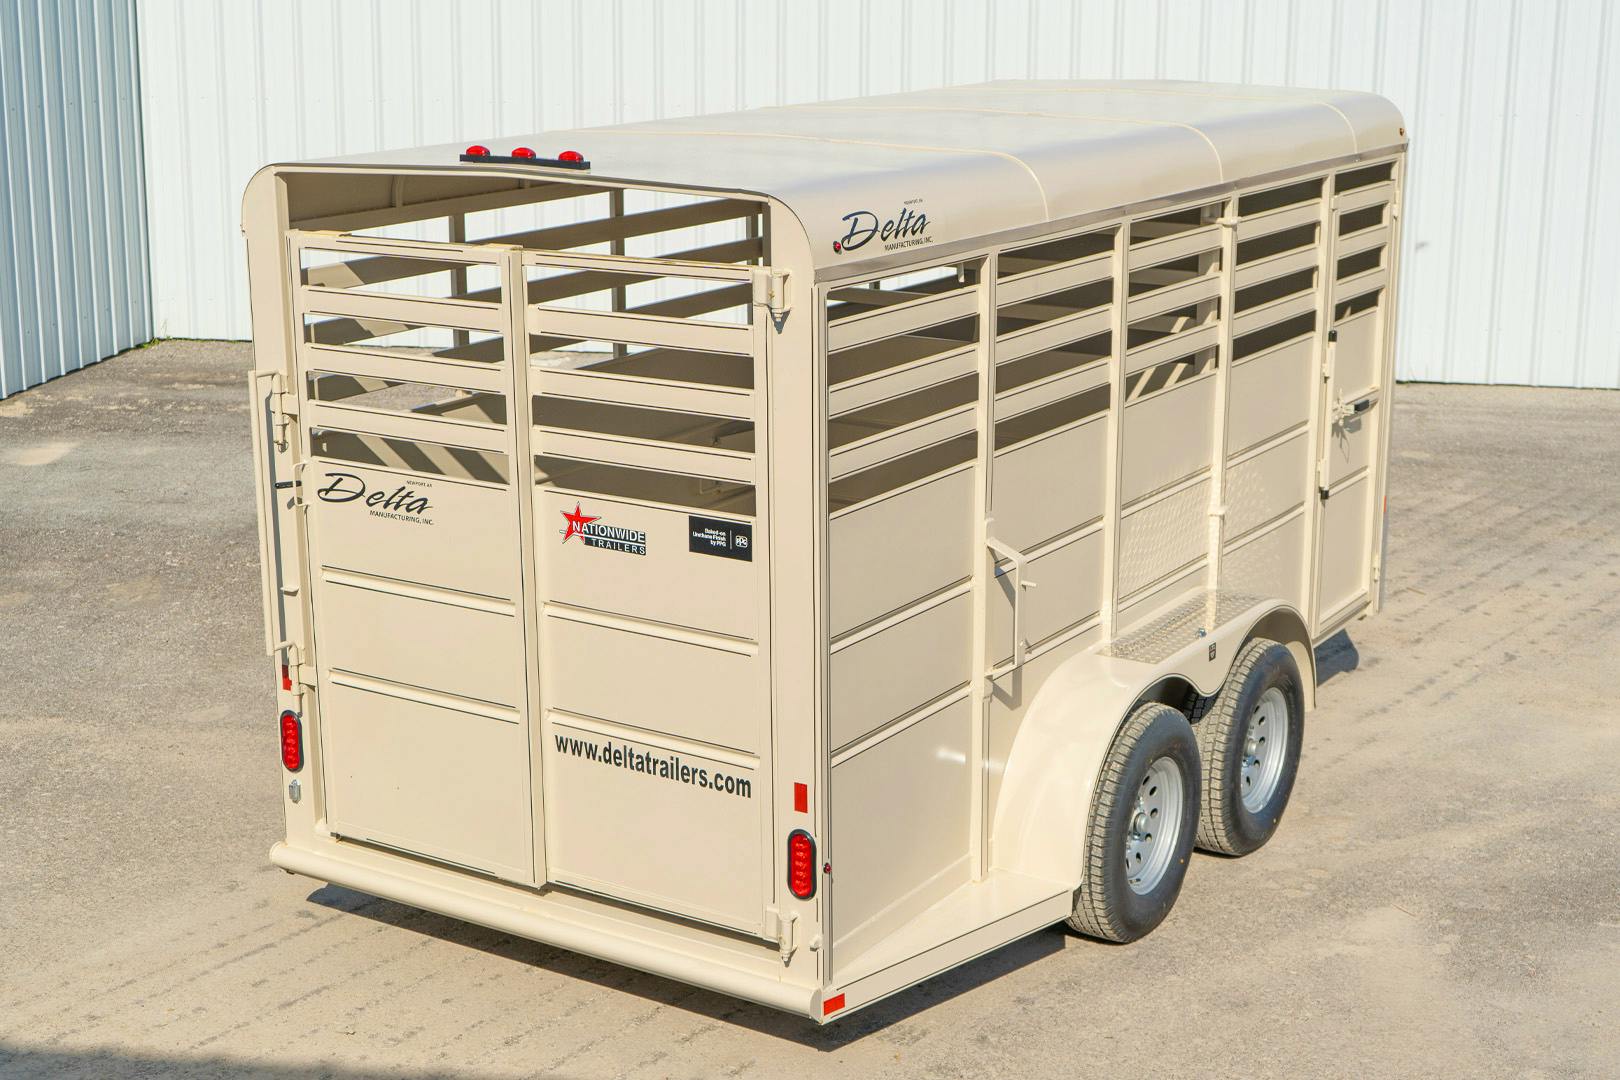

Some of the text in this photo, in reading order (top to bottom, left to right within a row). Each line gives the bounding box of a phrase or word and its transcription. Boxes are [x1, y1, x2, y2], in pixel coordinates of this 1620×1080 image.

[841, 208, 931, 251] Delta
[318, 472, 433, 514] Delta
[572, 520, 645, 543] NATIONWIDE
[591, 538, 646, 555] TRAILERS
[555, 734, 751, 798] www.deltatrailers.com
